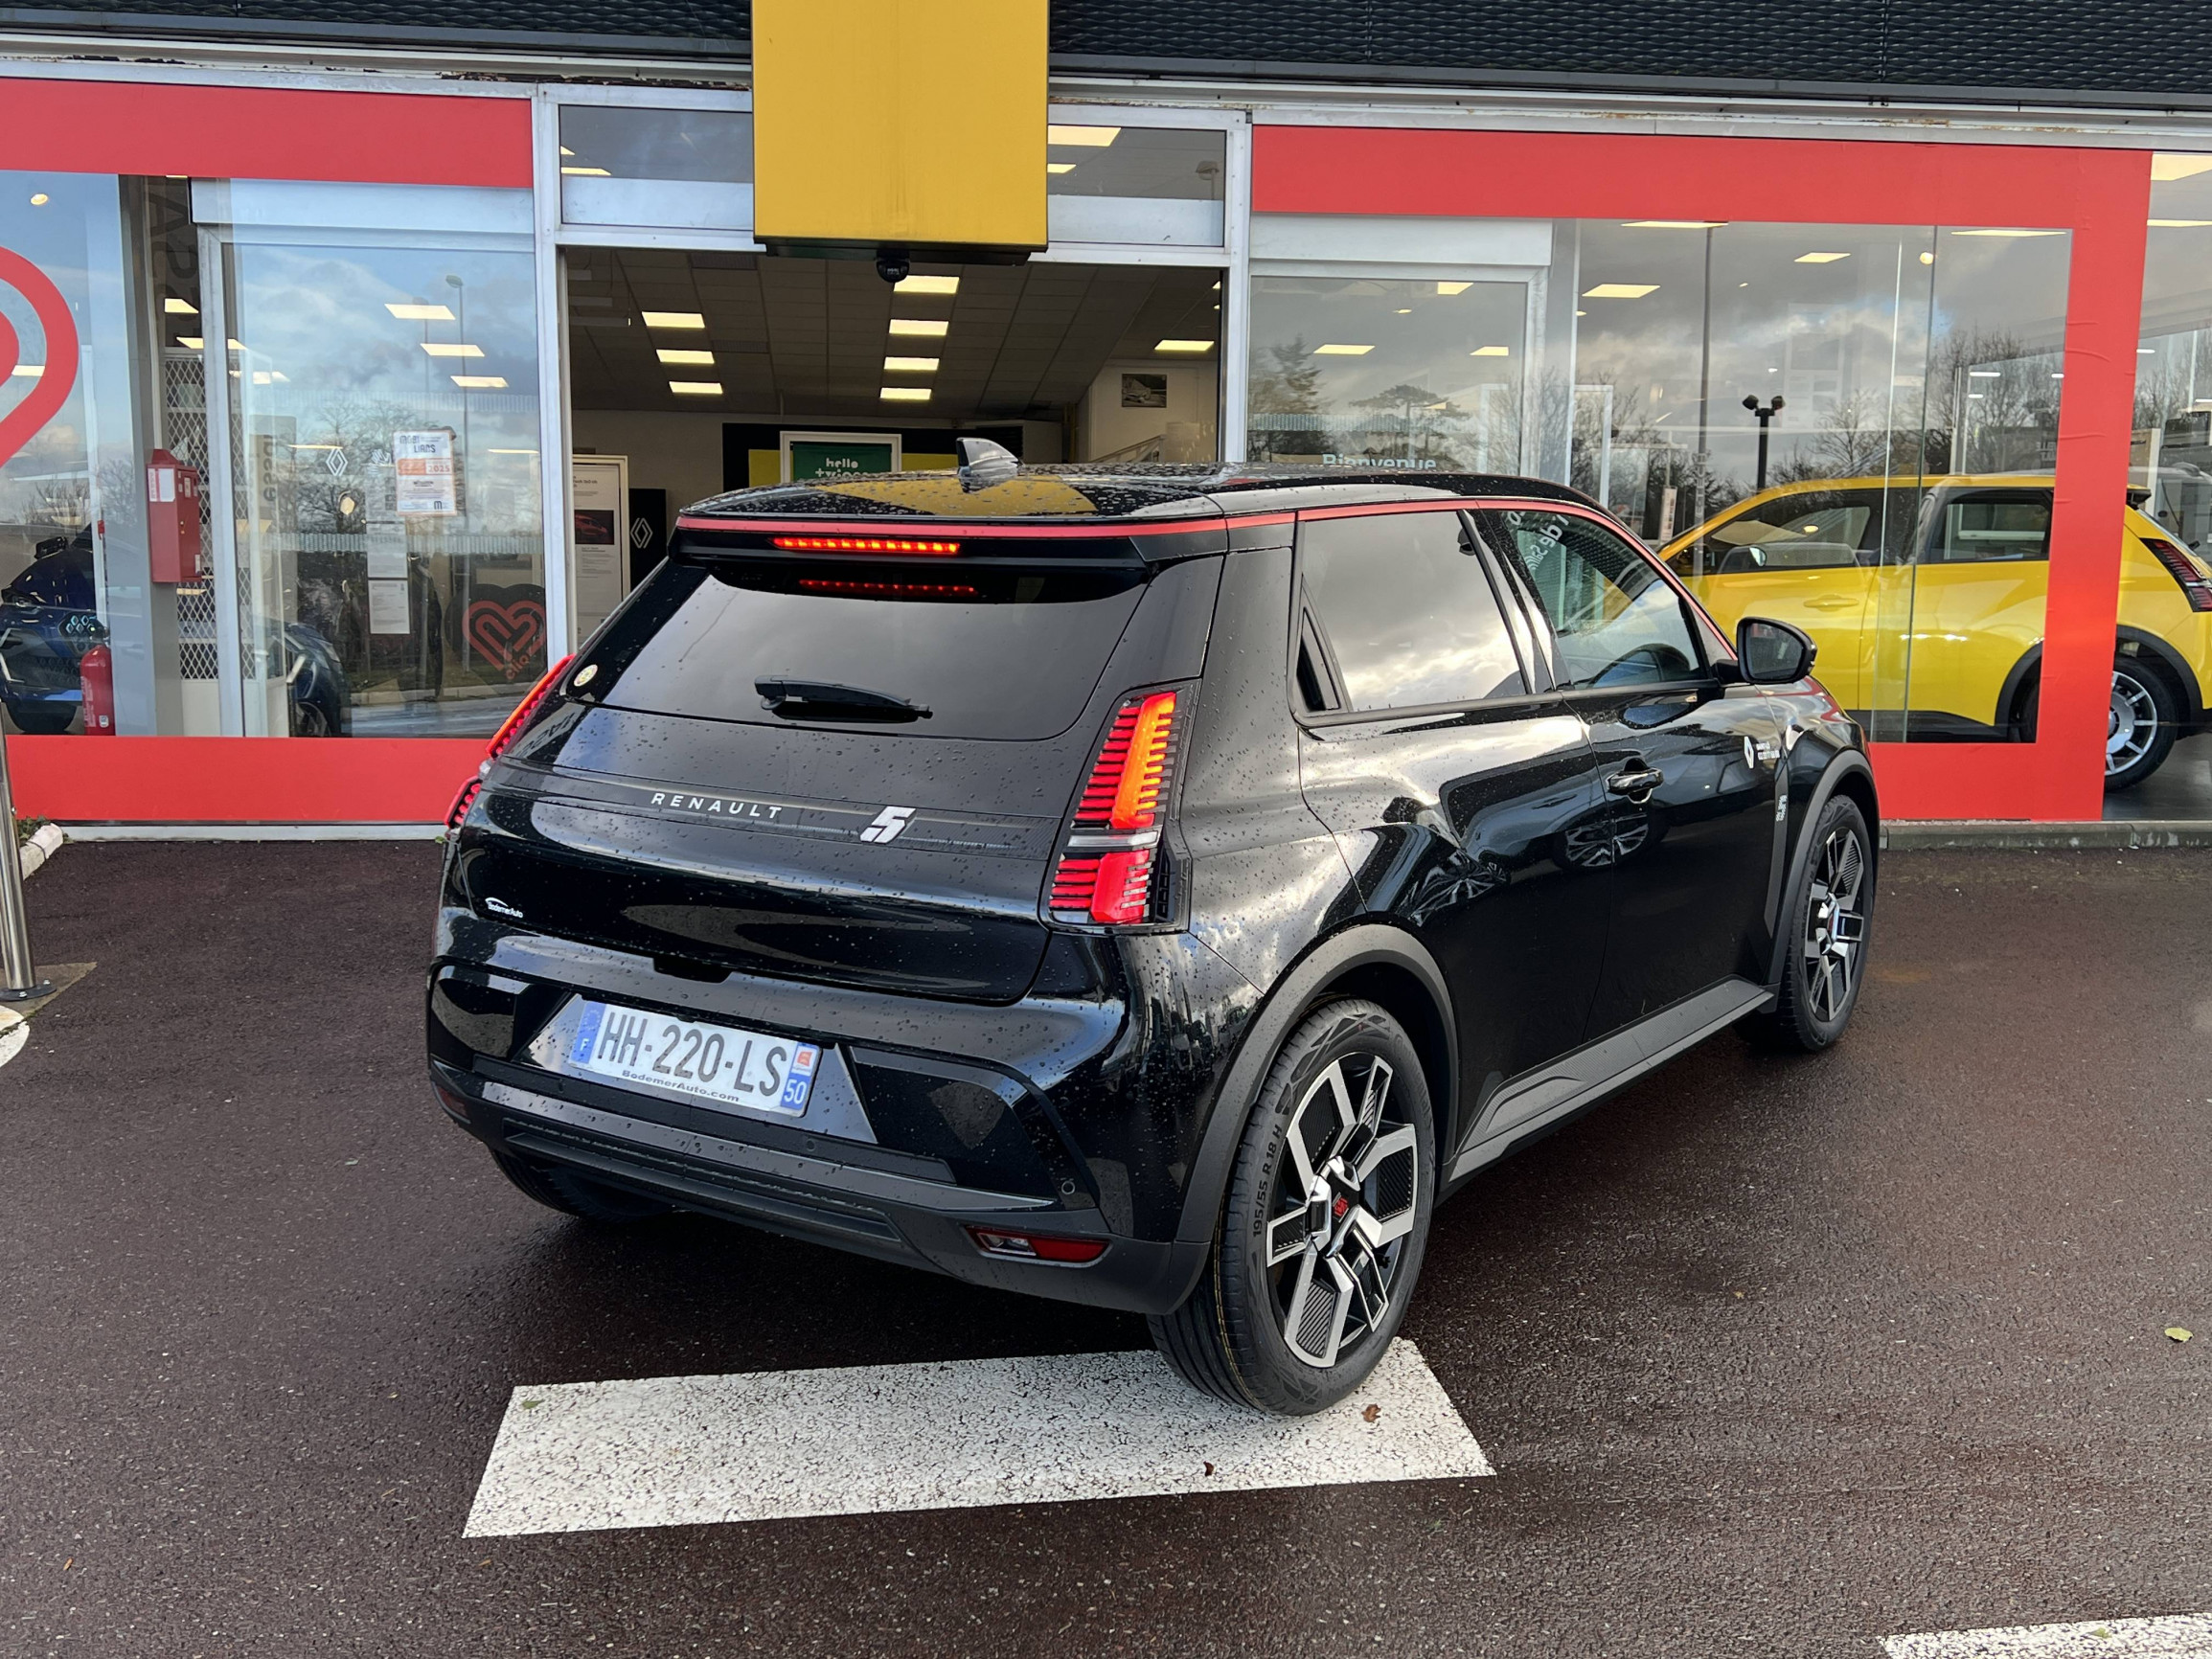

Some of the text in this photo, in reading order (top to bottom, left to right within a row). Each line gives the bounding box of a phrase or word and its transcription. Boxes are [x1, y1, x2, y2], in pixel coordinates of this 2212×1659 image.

[826, 457, 859, 468] hello
[650, 792, 916, 844] RENAULT 5
[580, 1037, 590, 1051] F
[597, 1011, 787, 1097] HH-220-LS
[622, 1069, 740, 1102] BodemerAuto.com
[784, 1079, 808, 1104] 50
[1253, 1124, 1283, 1238] 195/55 R 18 H
